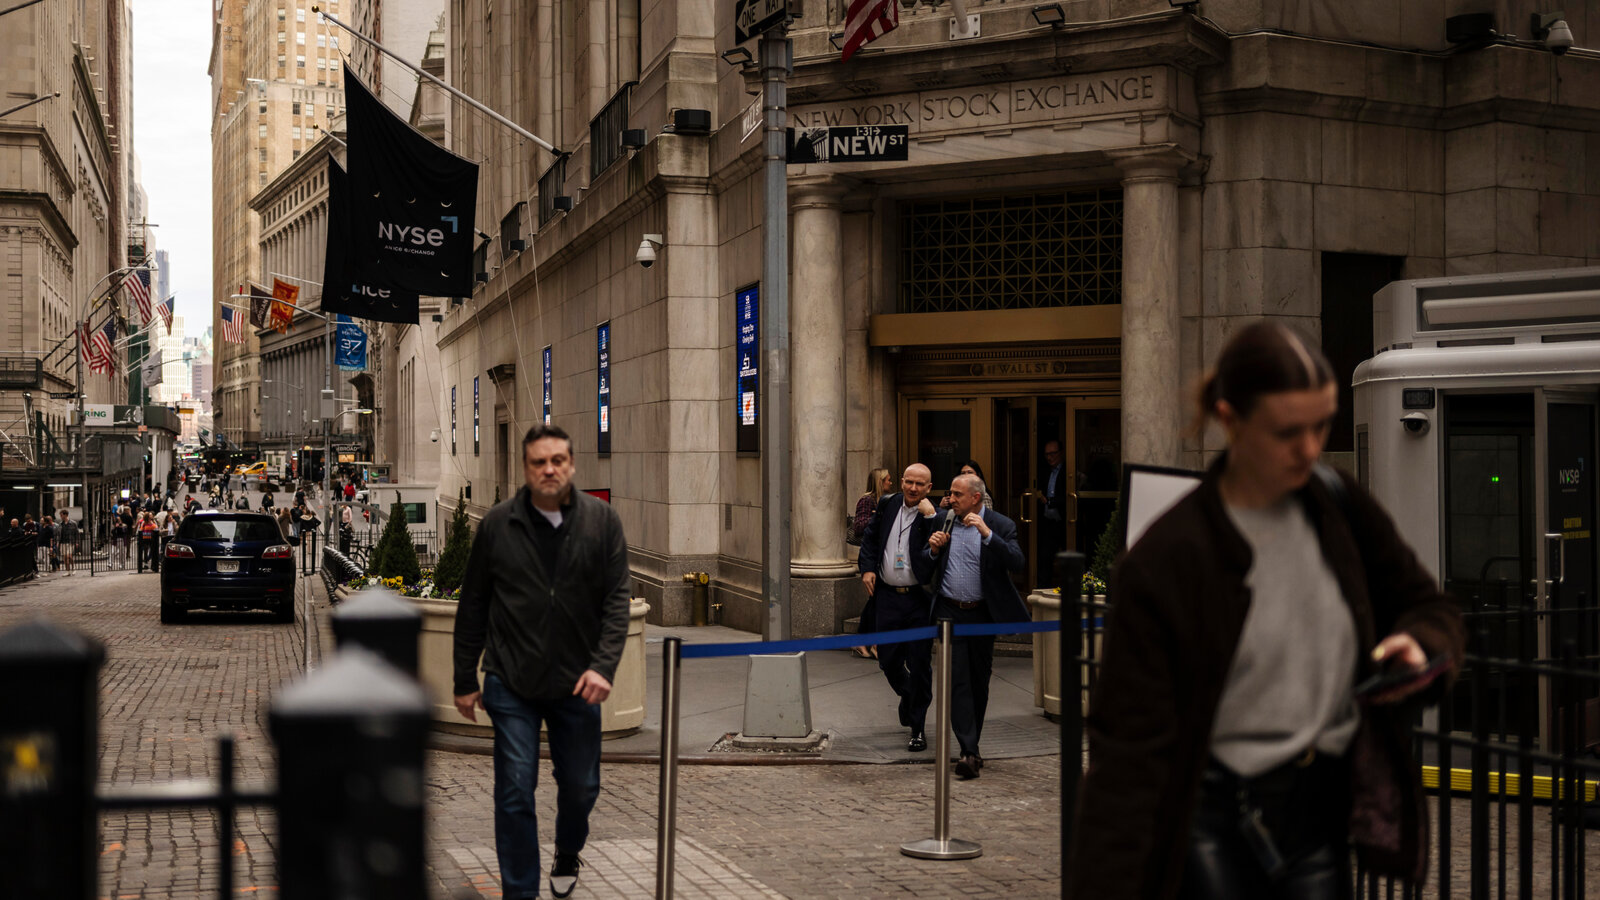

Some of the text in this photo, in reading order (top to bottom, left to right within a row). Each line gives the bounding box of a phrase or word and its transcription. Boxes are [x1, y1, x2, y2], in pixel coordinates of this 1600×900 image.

[742, 6, 756, 28] ONE
[851, 102, 914, 125] YORK
[923, 91, 1001, 121] STOCK
[1015, 75, 1154, 113] EXCHANGE
[856, 127, 872, 136] 1-31
[833, 135, 905, 155] NEW ST
[1000, 364, 1032, 374] WALL
[1035, 363, 1048, 373] ST
